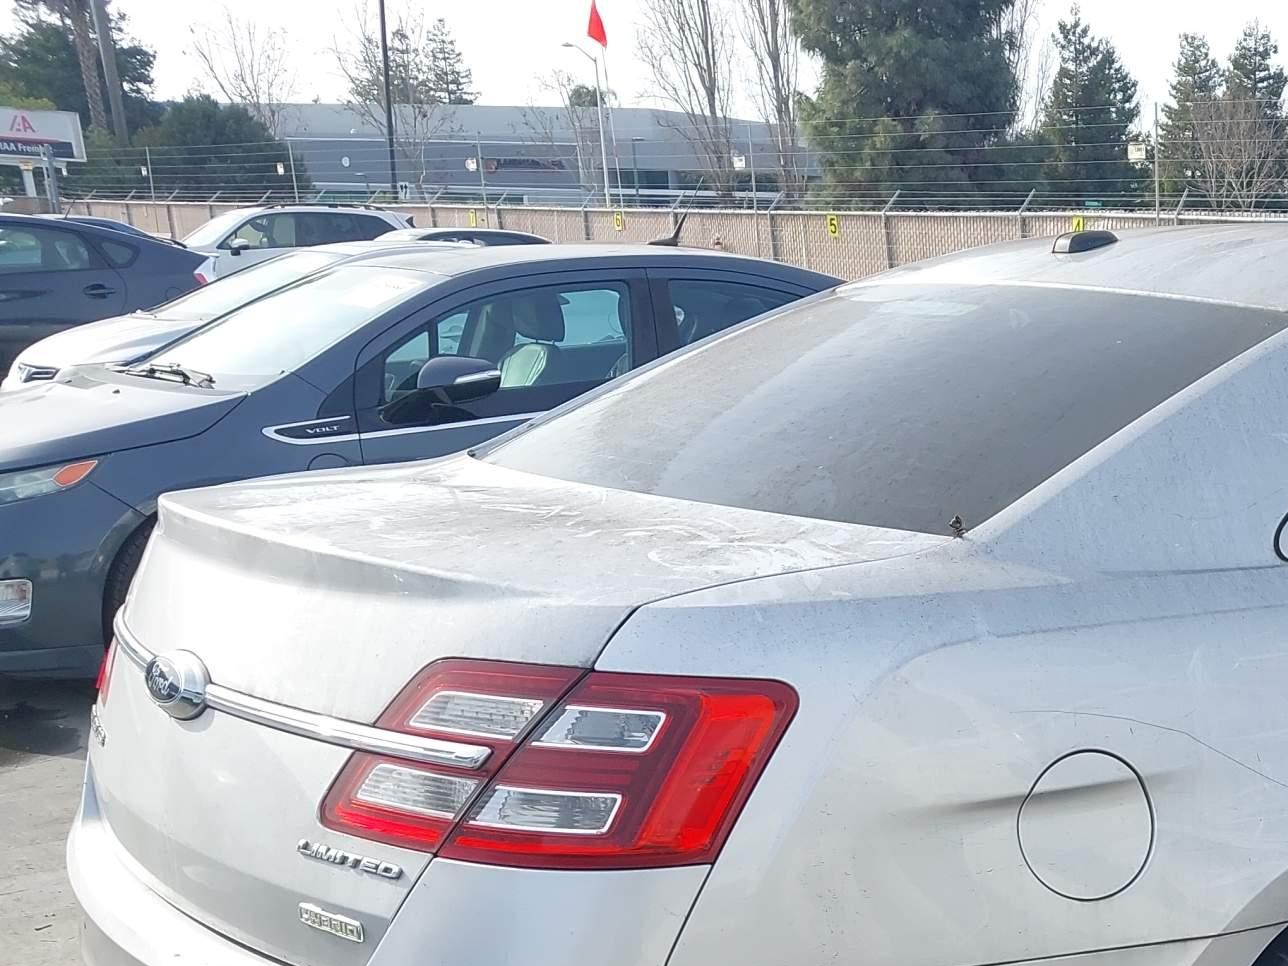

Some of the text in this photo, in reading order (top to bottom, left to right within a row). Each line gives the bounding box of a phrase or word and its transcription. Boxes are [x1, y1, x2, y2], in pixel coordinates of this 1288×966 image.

[615, 213, 621, 227] 6
[829, 217, 837, 234] 5
[305, 425, 340, 434] VOLT
[149, 662, 174, 696] Ford
[297, 839, 404, 880] LIMITED
